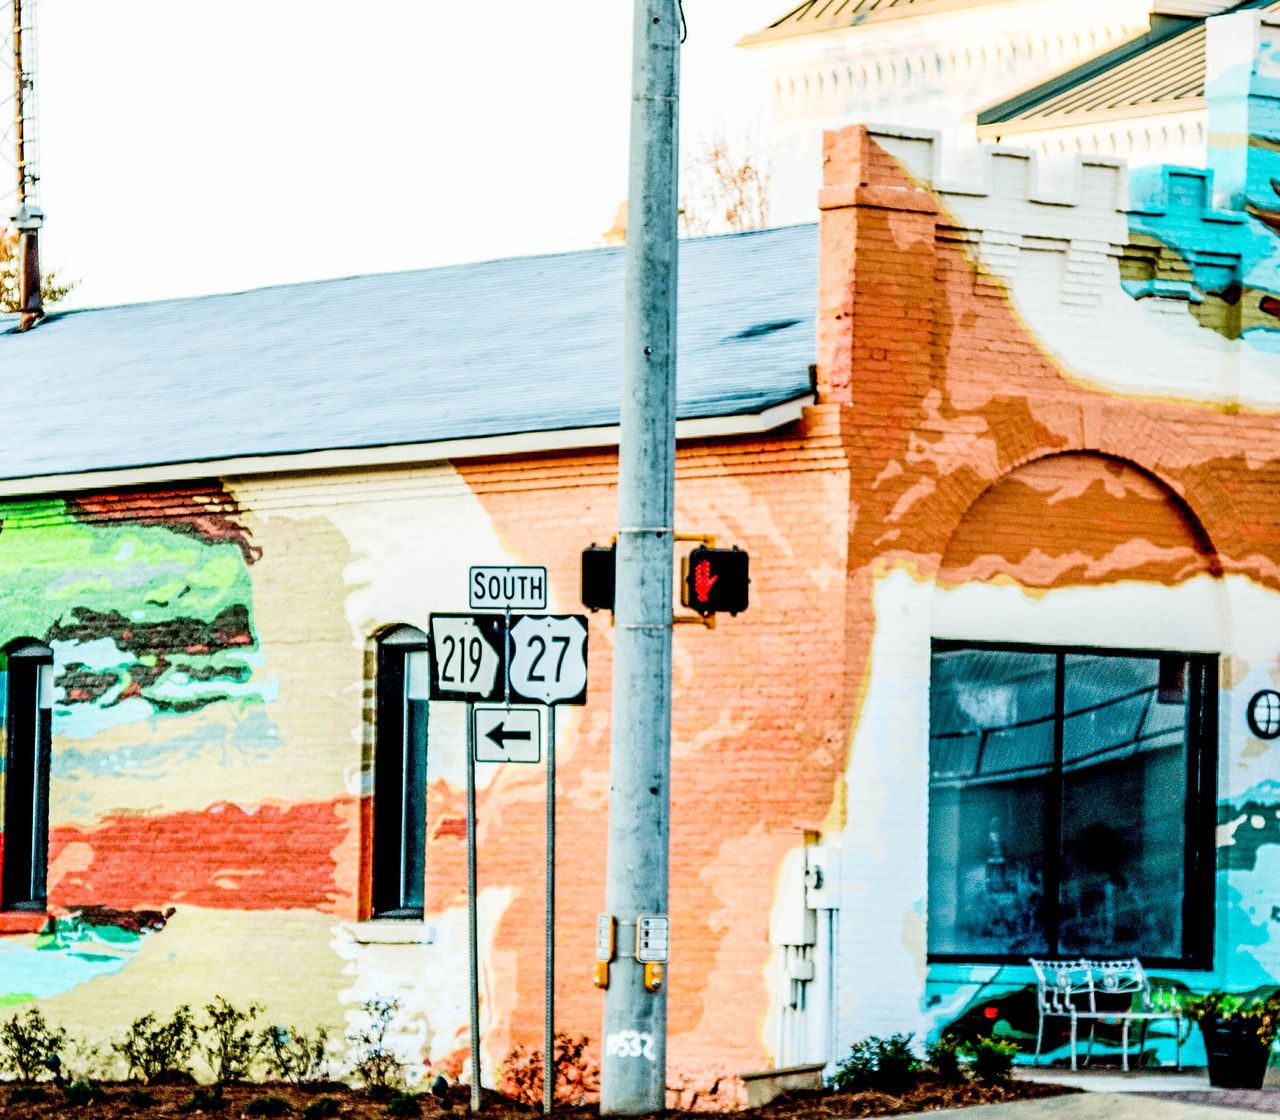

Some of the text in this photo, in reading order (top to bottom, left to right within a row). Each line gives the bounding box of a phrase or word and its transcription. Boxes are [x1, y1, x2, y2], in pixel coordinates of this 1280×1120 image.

[474, 572, 542, 600] SOUTH
[442, 635, 482, 683] 219
[527, 635, 570, 682] 27
